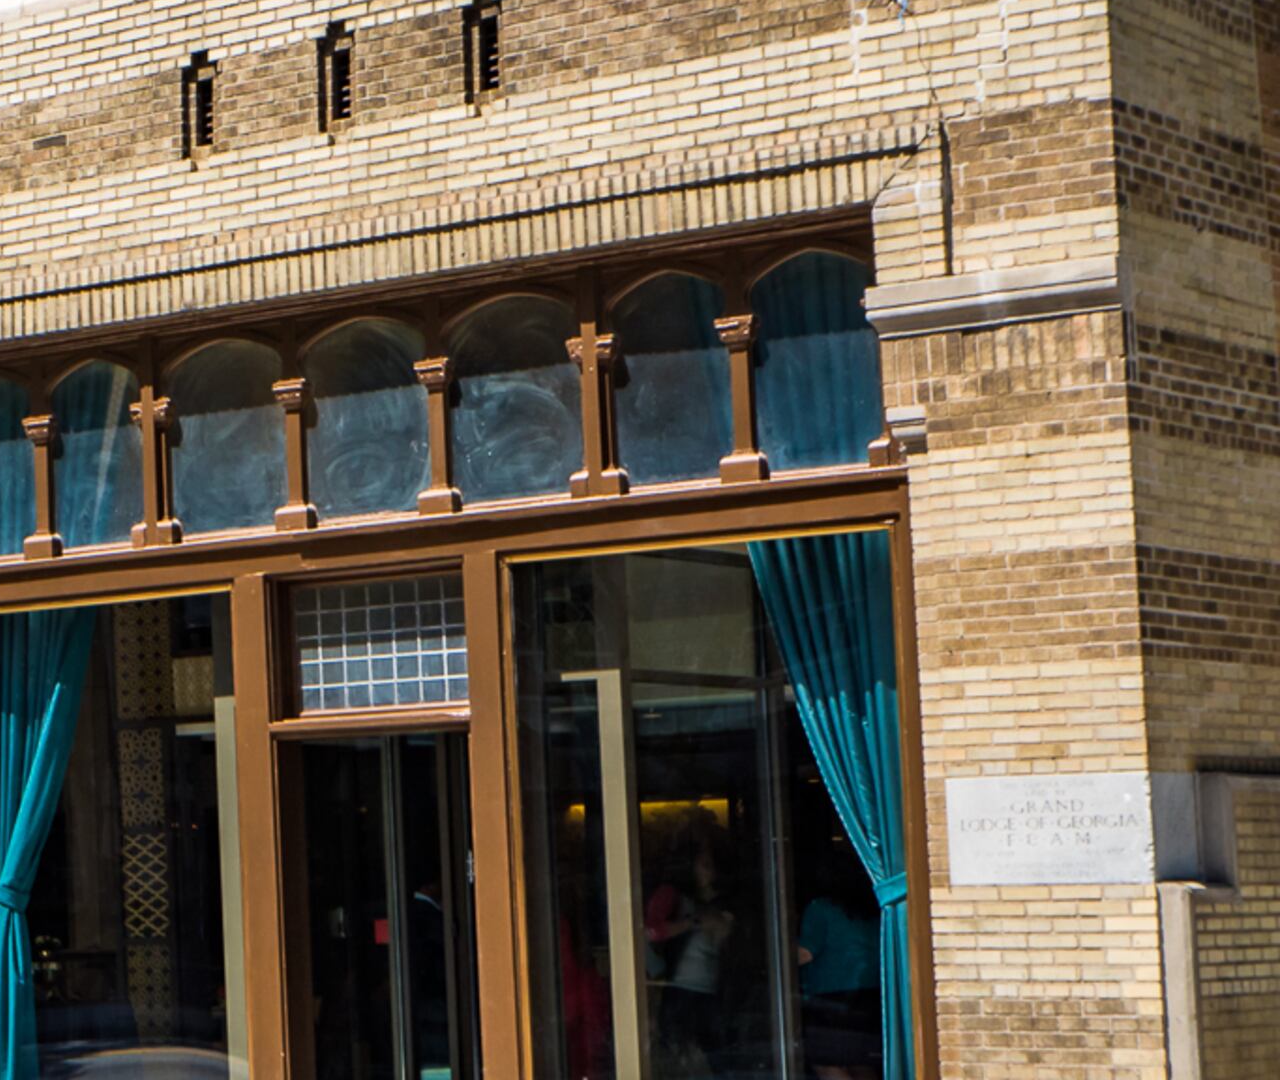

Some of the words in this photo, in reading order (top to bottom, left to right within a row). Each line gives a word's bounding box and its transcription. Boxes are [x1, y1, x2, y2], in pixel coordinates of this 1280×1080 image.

[1009, 799, 1085, 815] GRAND
[960, 817, 1017, 832] LODGE
[1025, 817, 1047, 831] OF
[1056, 813, 1140, 830] GEORGIA
